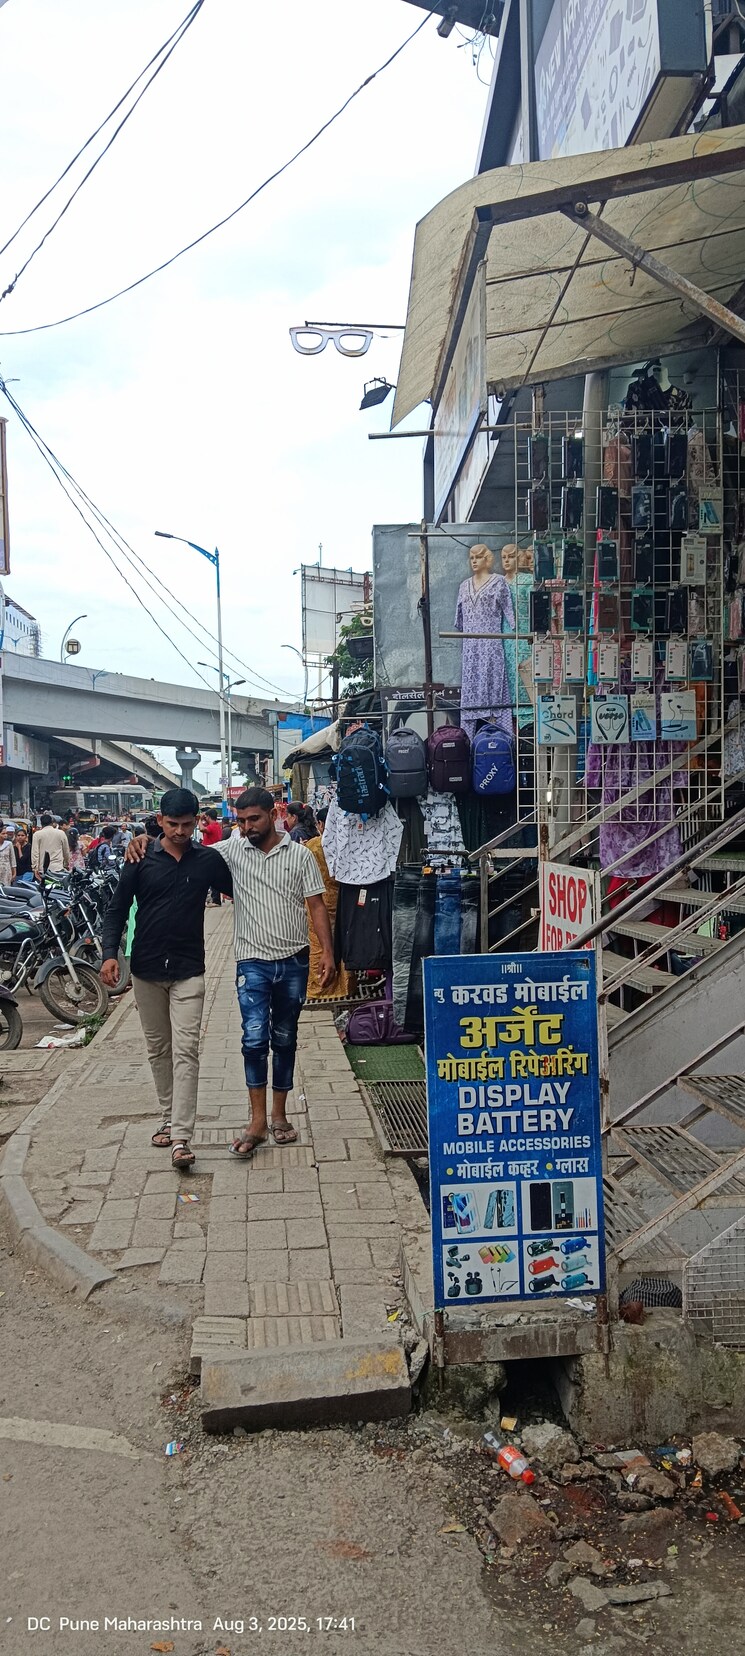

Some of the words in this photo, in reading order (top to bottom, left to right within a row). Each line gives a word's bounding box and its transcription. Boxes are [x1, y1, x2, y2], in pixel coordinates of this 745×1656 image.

[542, 710, 574, 720] Chord
[479, 764, 498, 790] PROXY
[548, 872, 588, 924] SHOP
[450, 984, 509, 1006] करवड
[514, 974, 590, 1003] मोबाईल
[460, 1005, 564, 1048] अर्जेंट
[436, 1050, 505, 1081] मोबाईल
[458, 1082, 572, 1109] DISPLAY
[457, 1108, 574, 1136] BATTERY
[443, 1140, 494, 1155] MOBILE
[498, 1135, 591, 1152] ACCESSORIES
[456, 1157, 504, 1179] मोबाईल
[507, 1160, 540, 1178] कव्हर
[555, 1157, 590, 1174] ग्लास
